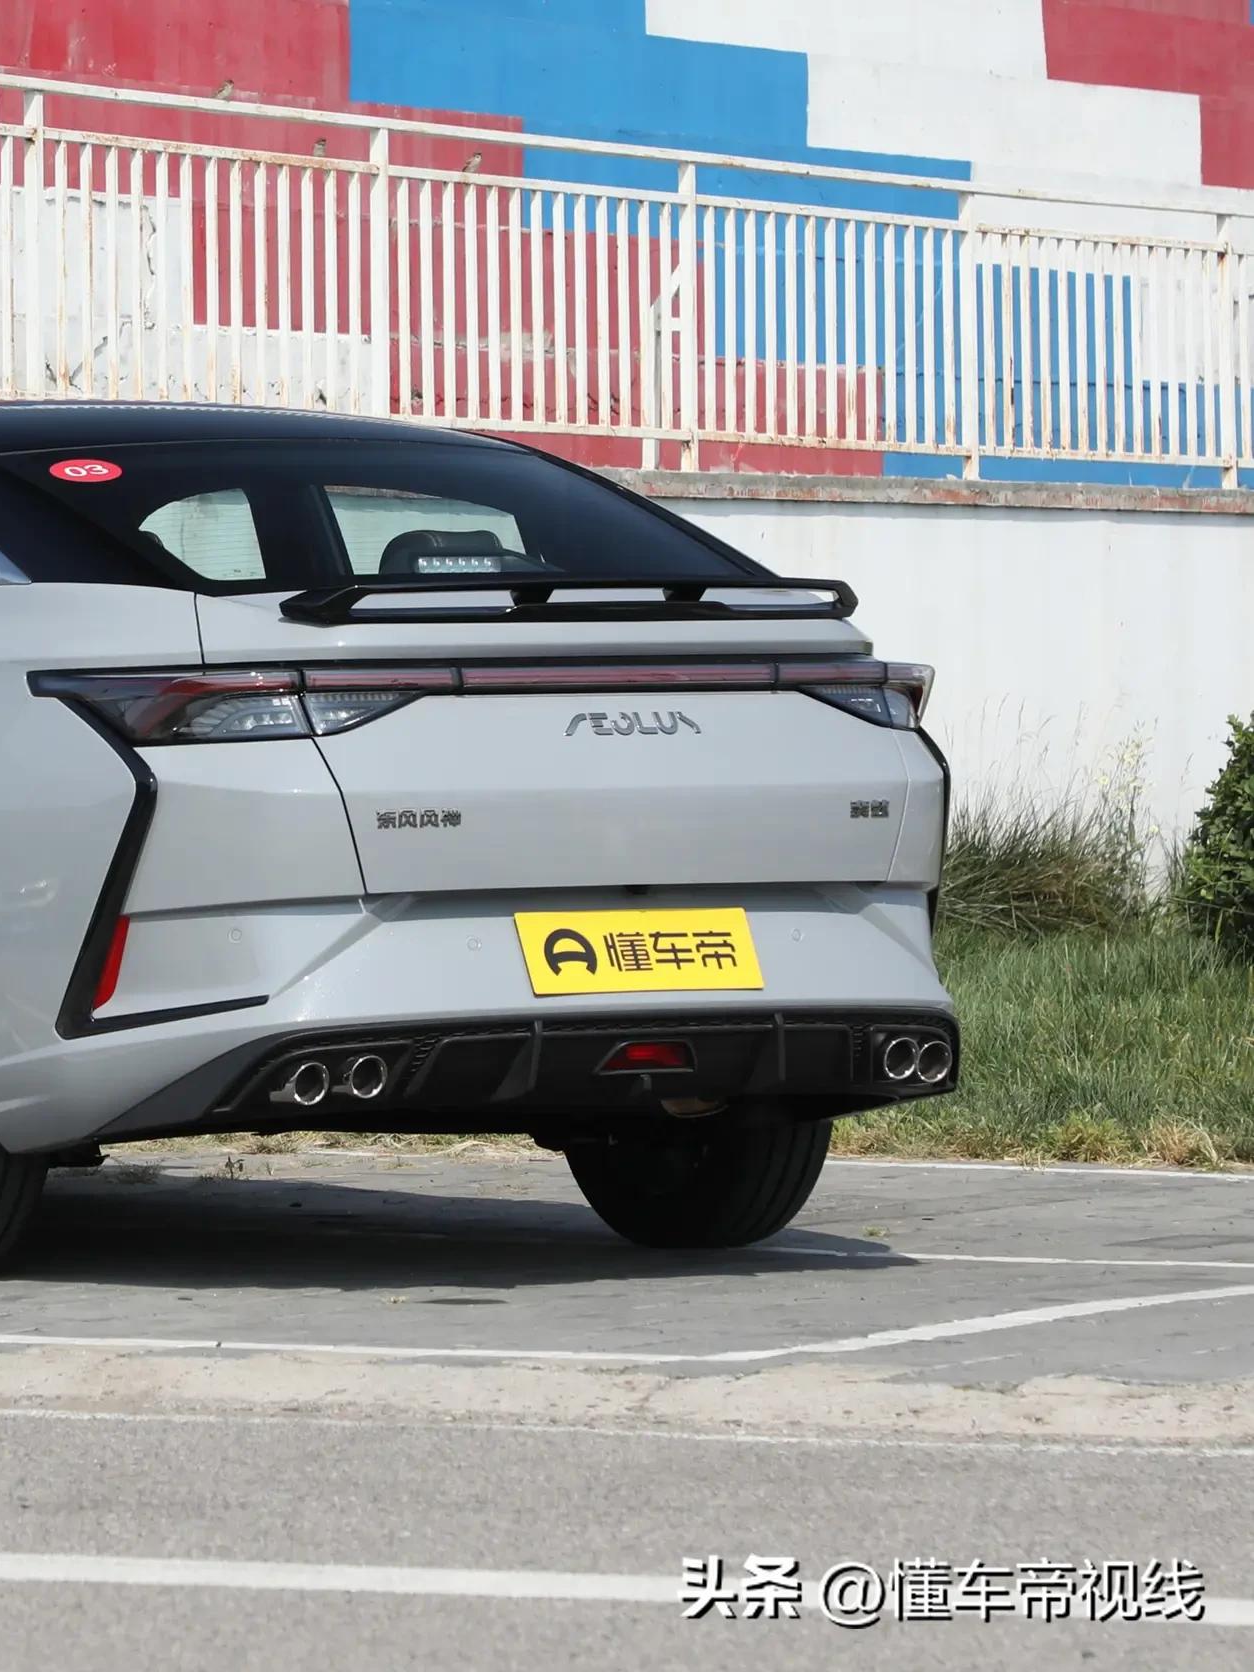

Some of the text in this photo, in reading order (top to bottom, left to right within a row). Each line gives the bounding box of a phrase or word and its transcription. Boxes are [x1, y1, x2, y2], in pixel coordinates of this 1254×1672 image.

[64, 464, 109, 477] 03
[603, 931, 737, 972] 懂车帝
